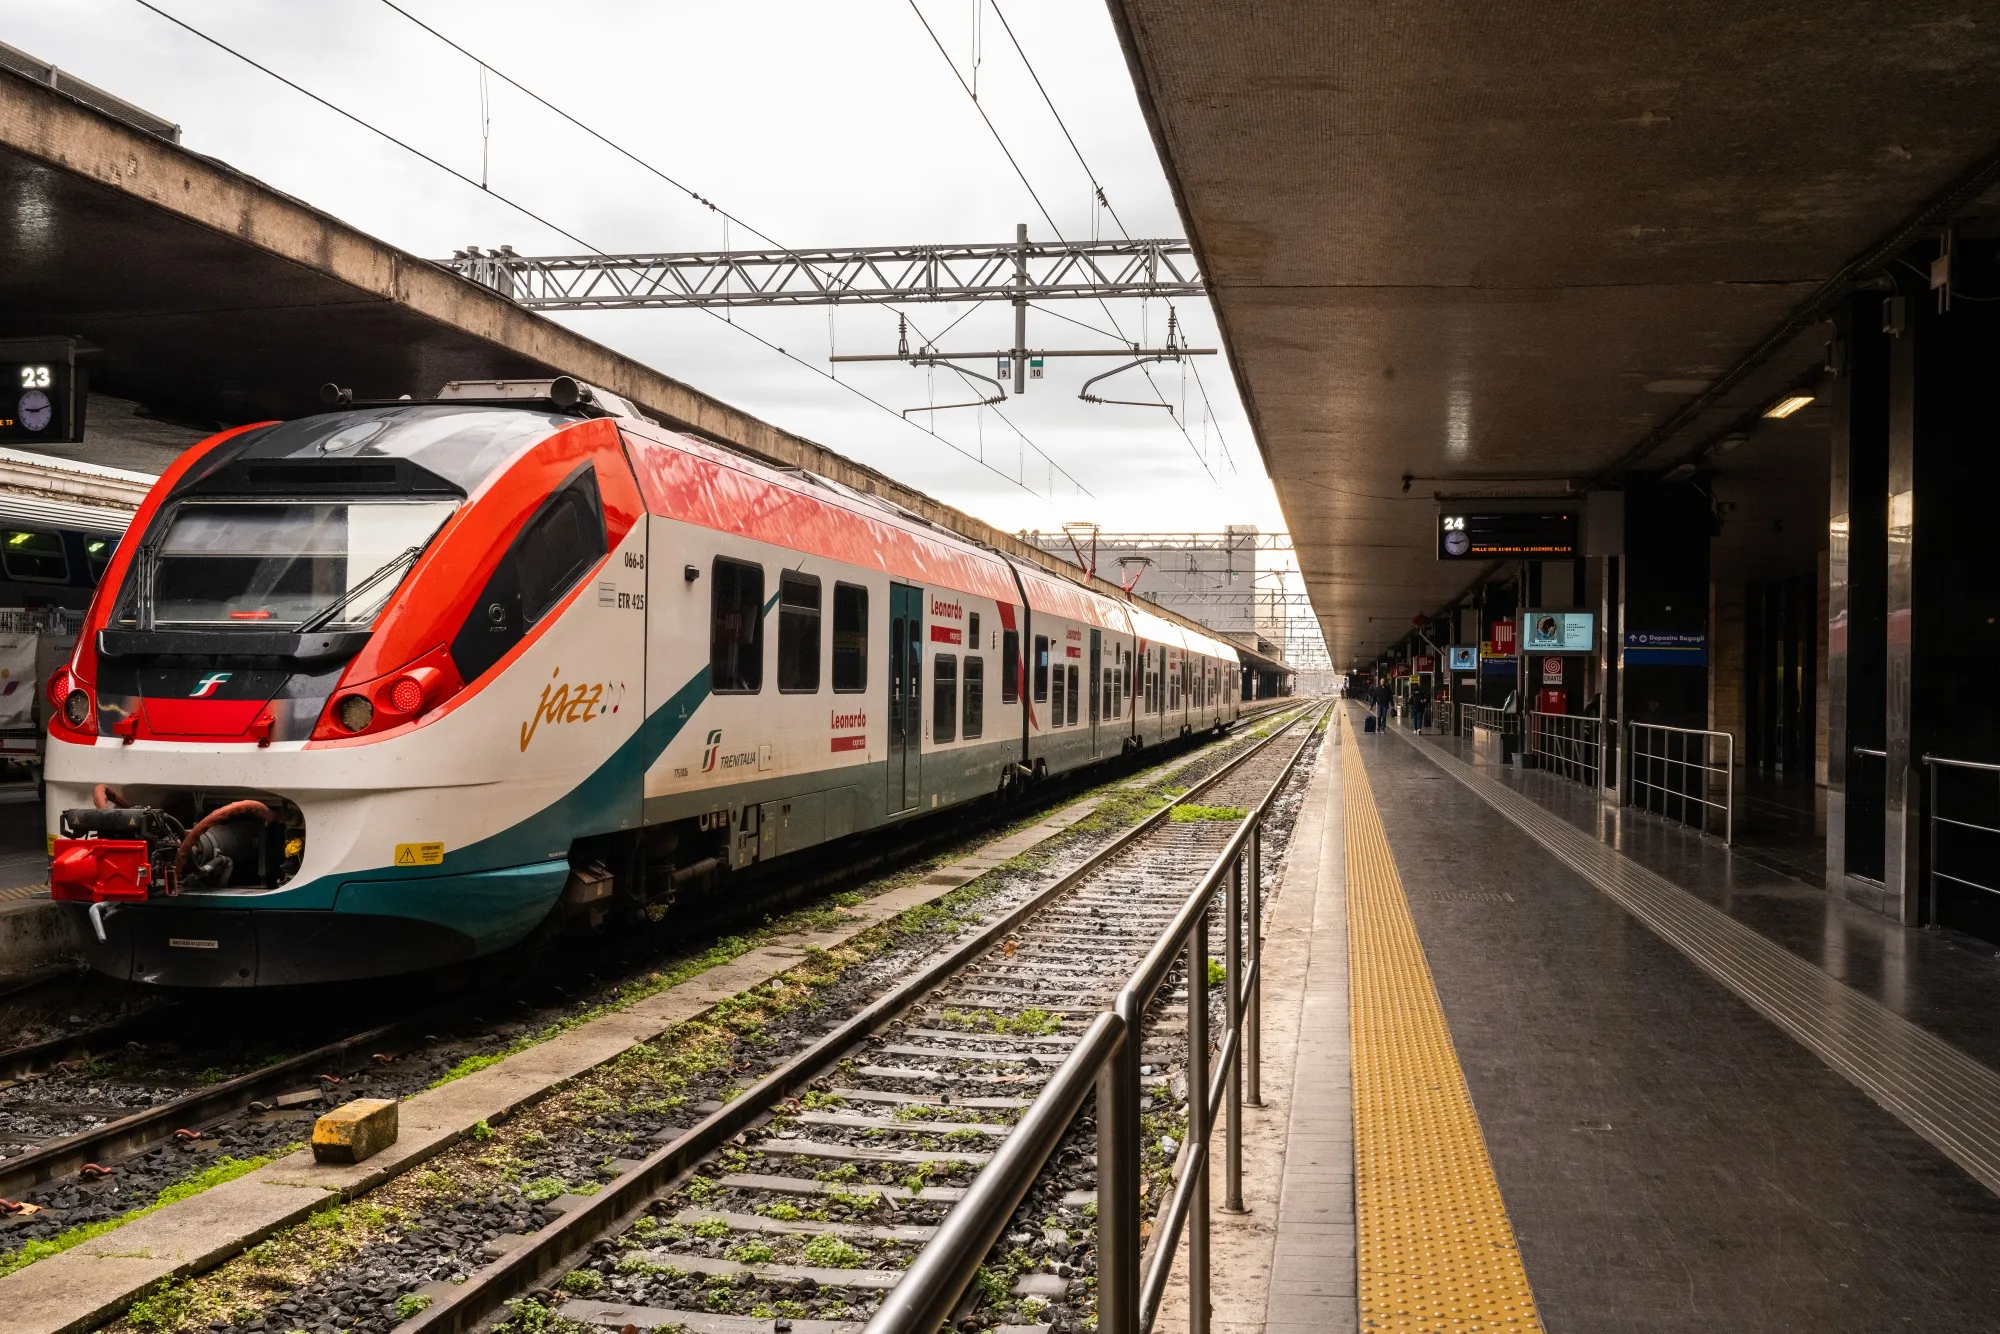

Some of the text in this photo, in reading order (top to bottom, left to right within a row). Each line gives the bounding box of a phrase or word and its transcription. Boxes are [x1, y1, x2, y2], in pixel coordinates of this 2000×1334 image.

[22, 367, 50, 387] 23
[1001, 369, 1007, 378] 9
[1032, 369, 1041, 377] 10
[1444, 517, 1464, 530] 24
[624, 551, 645, 570] 066-B
[618, 592, 644, 610] ETR 425
[930, 593, 963, 621] Leonardo
[1649, 634, 1705, 643] Deposito Bagagli
[1544, 674, 1562, 682] IDRANTE
[520, 666, 603, 753] jazz
[831, 707, 867, 730] Leonardo
[720, 751, 756, 770] TRENITALIA
